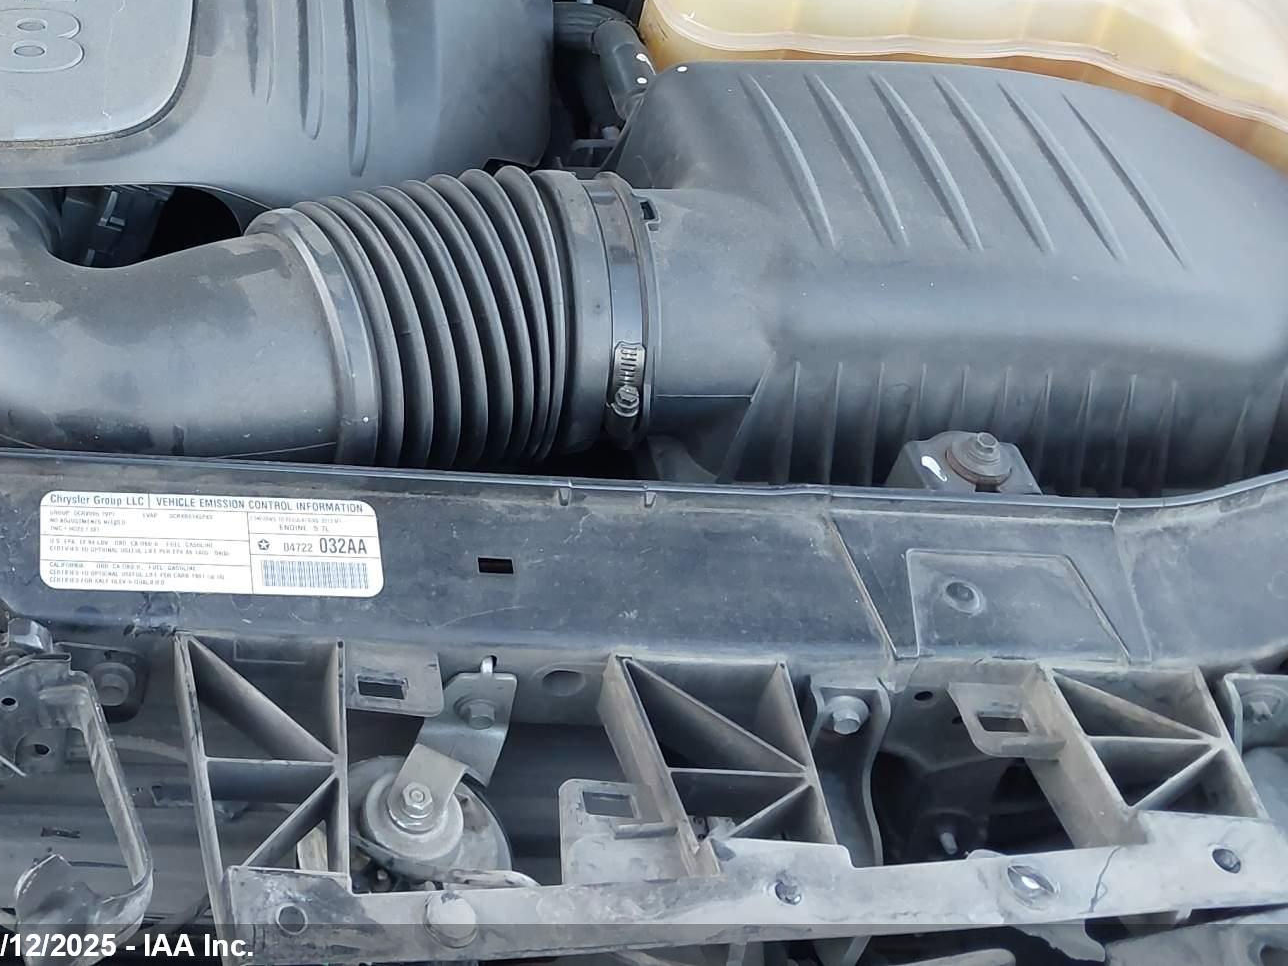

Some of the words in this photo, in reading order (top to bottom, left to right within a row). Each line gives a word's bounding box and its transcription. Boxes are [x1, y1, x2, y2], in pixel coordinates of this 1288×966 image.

[49, 494, 90, 506] Chrysler
[93, 495, 122, 507] Group
[126, 497, 144, 506] LLC
[156, 498, 196, 508] VEHICLE
[199, 498, 245, 509] EMISSION
[248, 500, 293, 511] CONTROL
[296, 502, 363, 512] INFORMATION
[319, 537, 368, 554] 032AA
